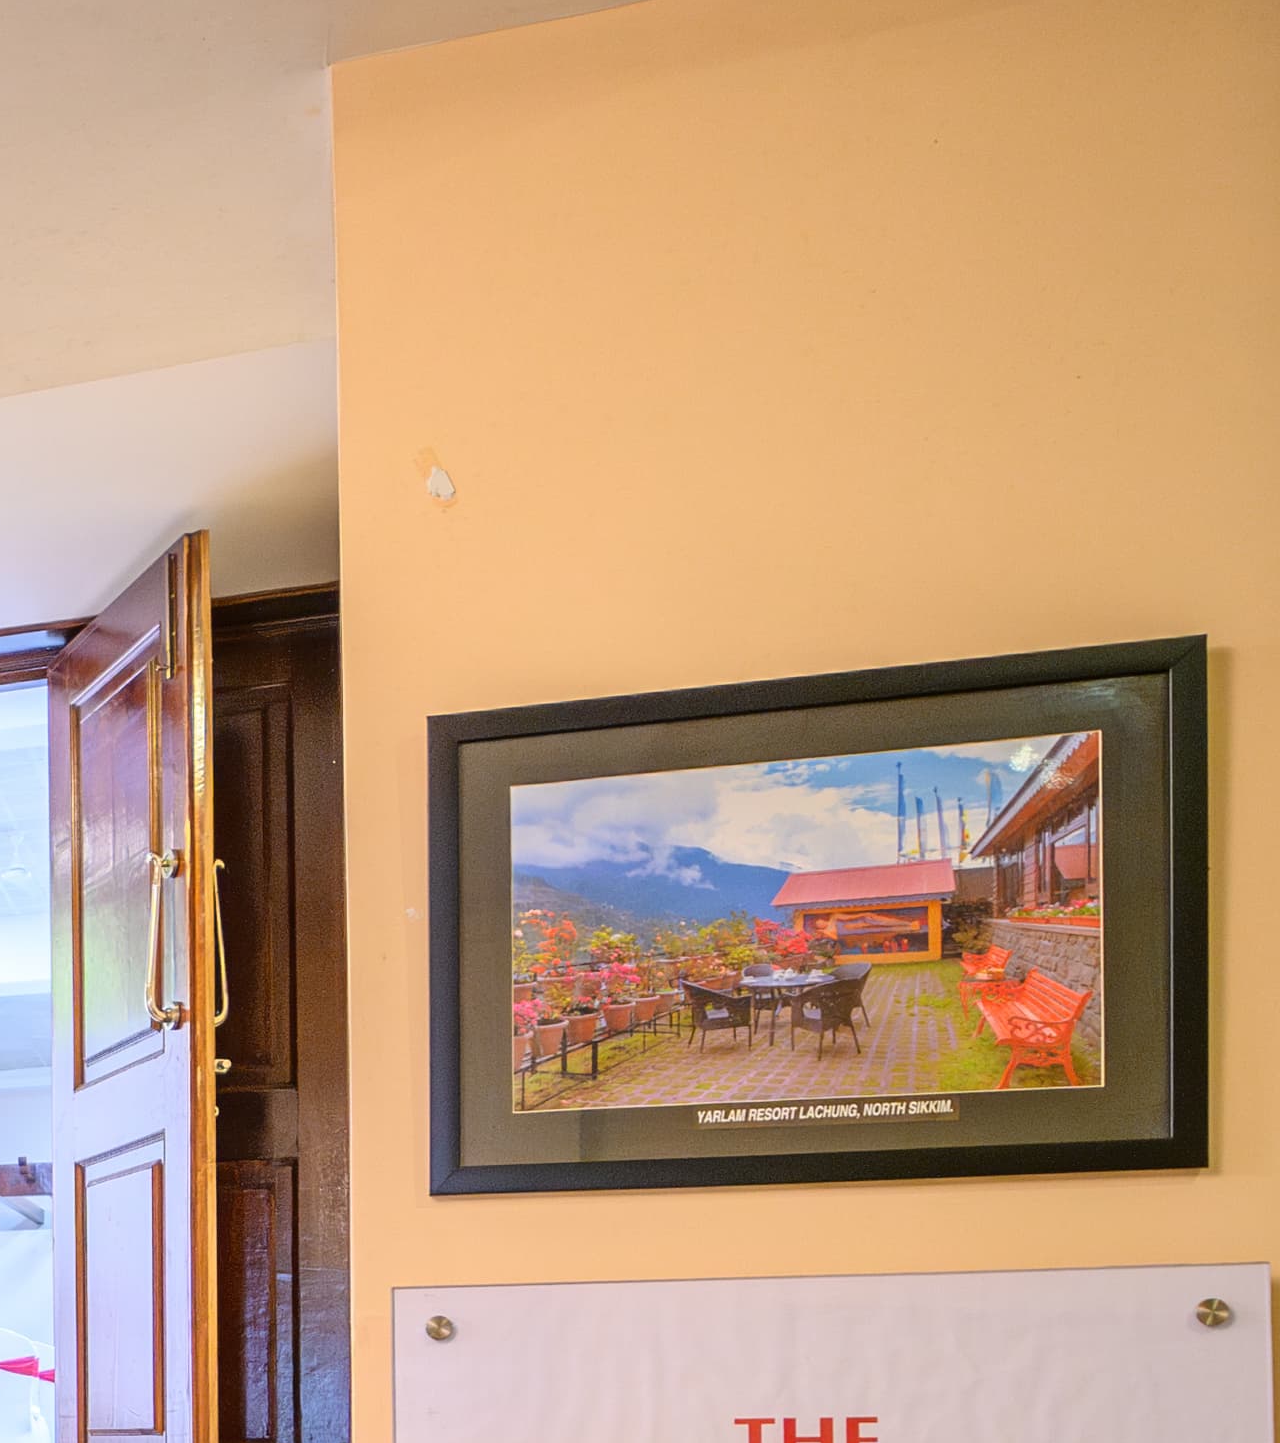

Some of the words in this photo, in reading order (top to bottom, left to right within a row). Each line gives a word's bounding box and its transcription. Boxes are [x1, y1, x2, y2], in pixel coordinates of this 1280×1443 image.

[697, 1108, 746, 1124] YARLAM
[748, 1106, 797, 1122] RESORT
[799, 1104, 861, 1120] LACHUNG,
[863, 1101, 906, 1117] NORTH
[908, 1099, 954, 1115] SIKKIM.
